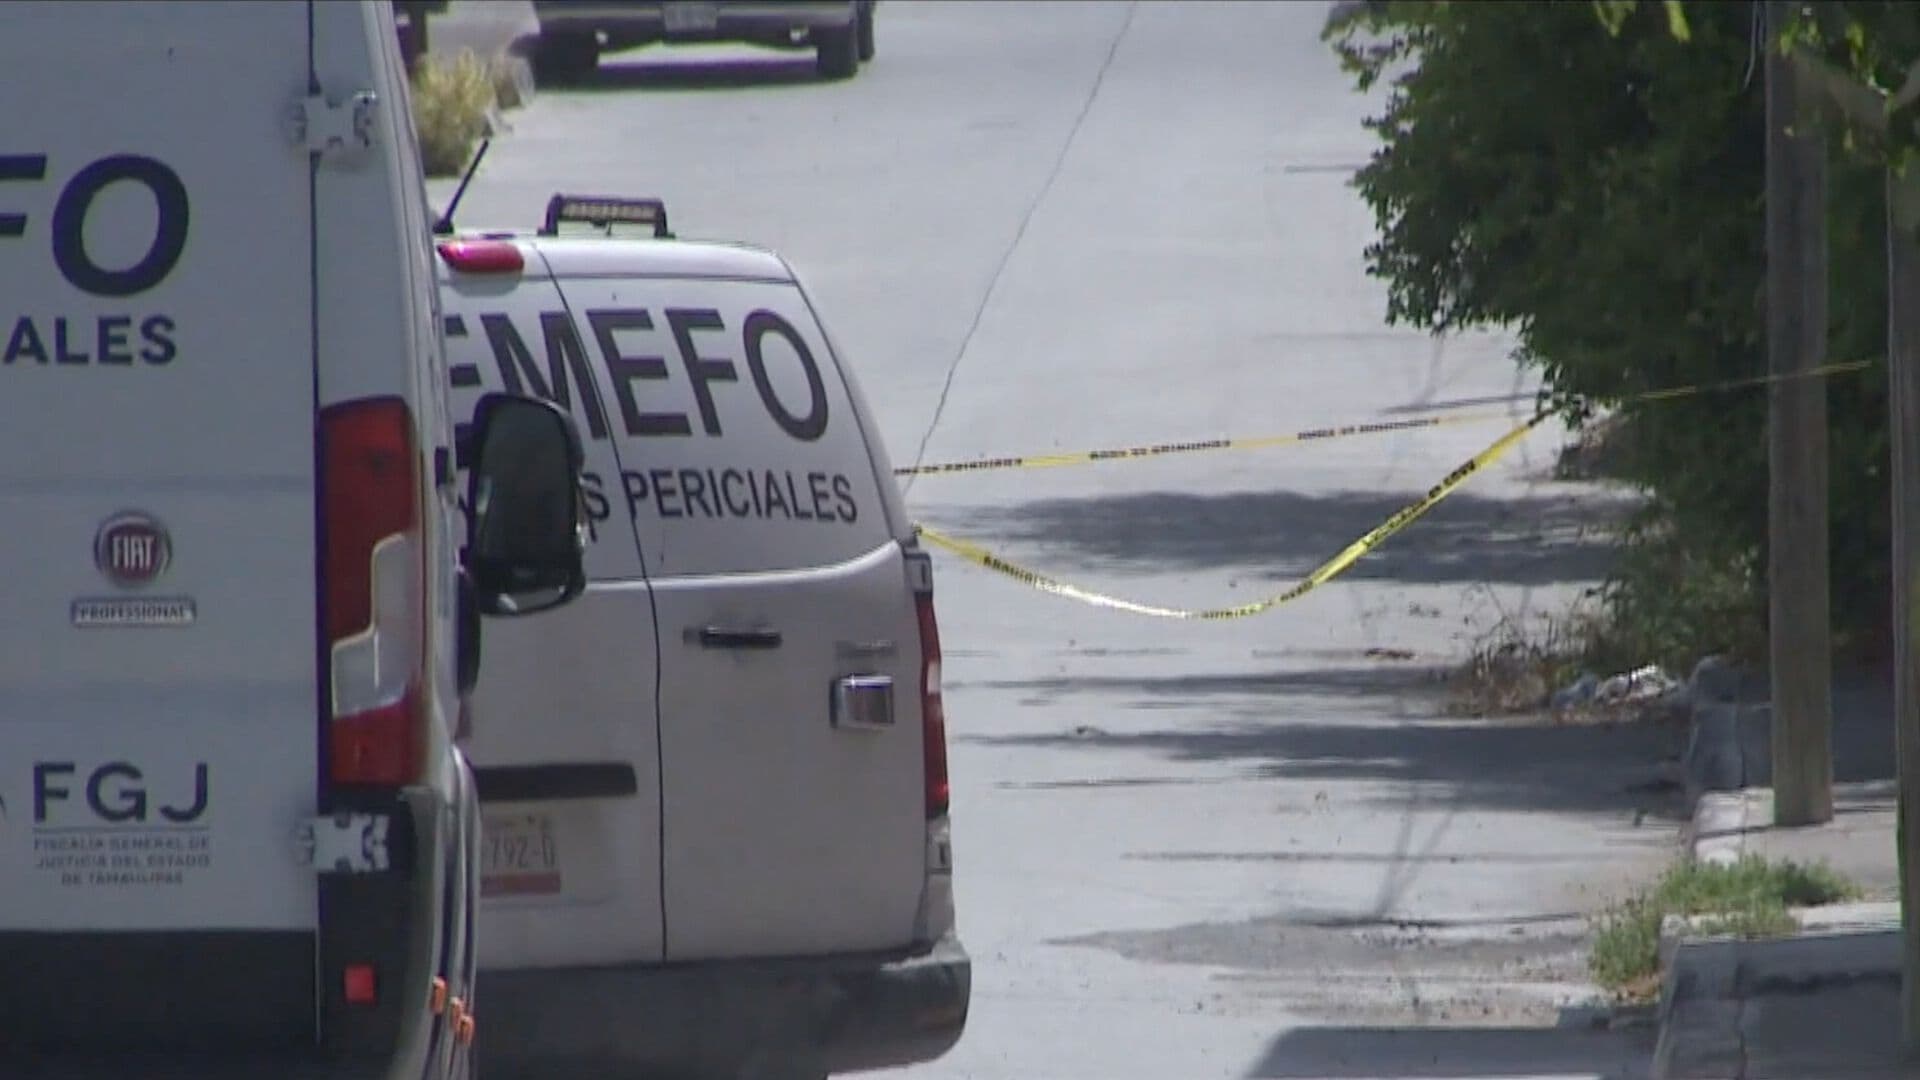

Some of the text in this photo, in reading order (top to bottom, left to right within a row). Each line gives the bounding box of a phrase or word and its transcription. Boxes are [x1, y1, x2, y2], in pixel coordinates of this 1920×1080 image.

[3, 314, 177, 365] ALES
[622, 470, 858, 524] PERICIALES
[112, 535, 156, 569] FIAT
[80, 604, 190, 619] PROFESSIONAL
[33, 762, 208, 823] FGJ
[189, 836, 210, 850] DE
[36, 853, 210, 868] JUSTICIA DEL ESTADO
[62, 872, 184, 886] DE TAMAULIPAS
